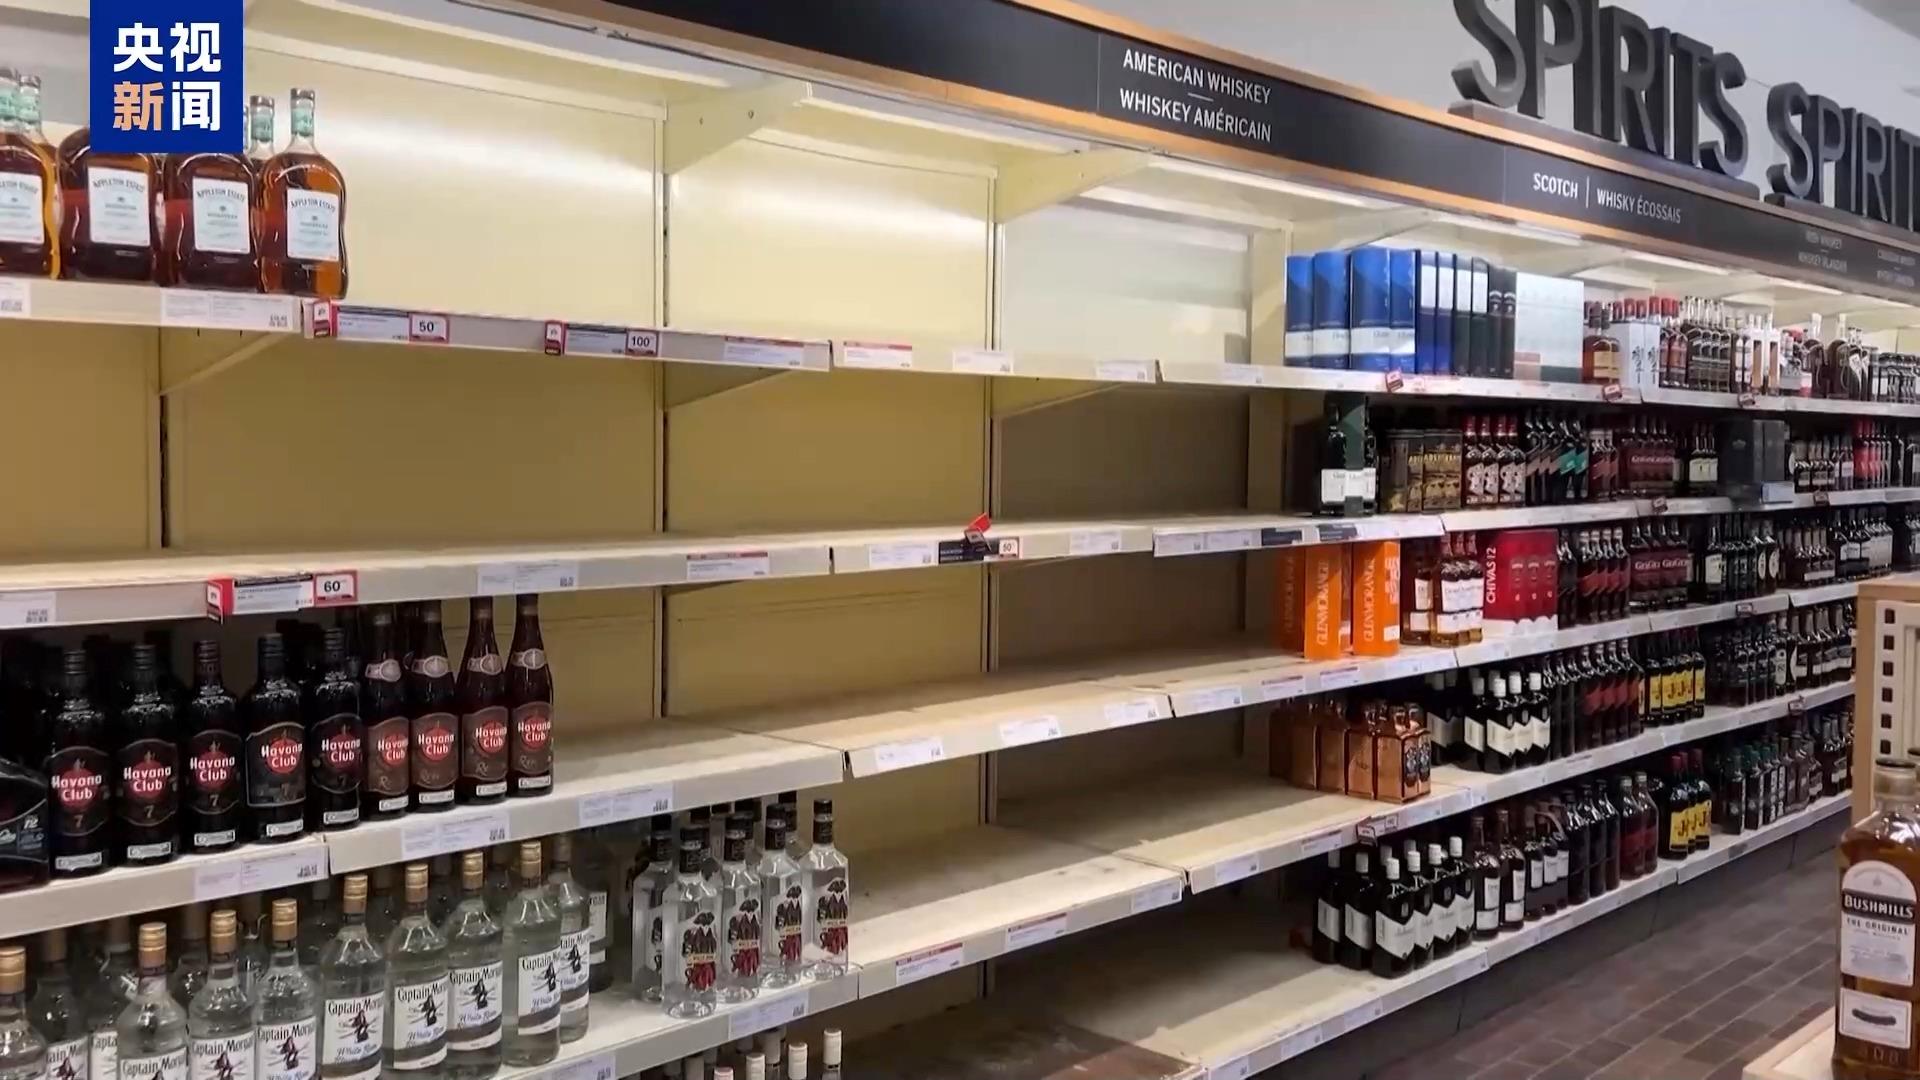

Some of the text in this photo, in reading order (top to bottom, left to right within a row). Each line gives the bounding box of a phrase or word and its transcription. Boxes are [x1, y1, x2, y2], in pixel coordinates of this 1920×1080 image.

[1123, 48, 1271, 105] AMERICAN WHISKEY
[1450, 0, 1749, 178] SPIRITS
[1120, 87, 1272, 143] WHISKEY AMÉRICAIN
[1533, 172, 1681, 224] SCOTCH WHISKY ÉCOSSAIS
[631, 336, 650, 348] 100
[1485, 546, 1496, 604] CHIVAS 12
[324, 580, 341, 593] 60
[517, 720, 551, 733] Havana
[321, 738, 361, 751] Havana
[418, 733, 455, 746] Havana
[483, 737, 504, 748] Club
[525, 731, 547, 743] Club
[261, 743, 303, 758] Havana
[330, 750, 355, 763] Club
[386, 750, 407, 761] Club
[426, 744, 449, 756] Club
[189, 756, 236, 771] Havana
[271, 756, 297, 768] Club
[123, 766, 172, 781] Havana
[199, 769, 228, 782] Club
[51, 774, 102, 789] Havana
[133, 779, 163, 793] Club
[61, 788, 93, 802] Club
[209, 794, 220, 807] 7
[144, 804, 156, 819] 7
[74, 814, 84, 828] 7
[1844, 894, 1913, 920] BUSHMILLS
[1865, 921, 1909, 936] ORIGINAL
[522, 955, 551, 971] Captain
[449, 971, 479, 985] Captain
[398, 987, 430, 1002] Captain
[328, 1000, 361, 1016] Captain
[257, 1027, 290, 1042] Captain
[192, 1042, 225, 1058] Captain
[122, 1060, 160, 1077] Captain
